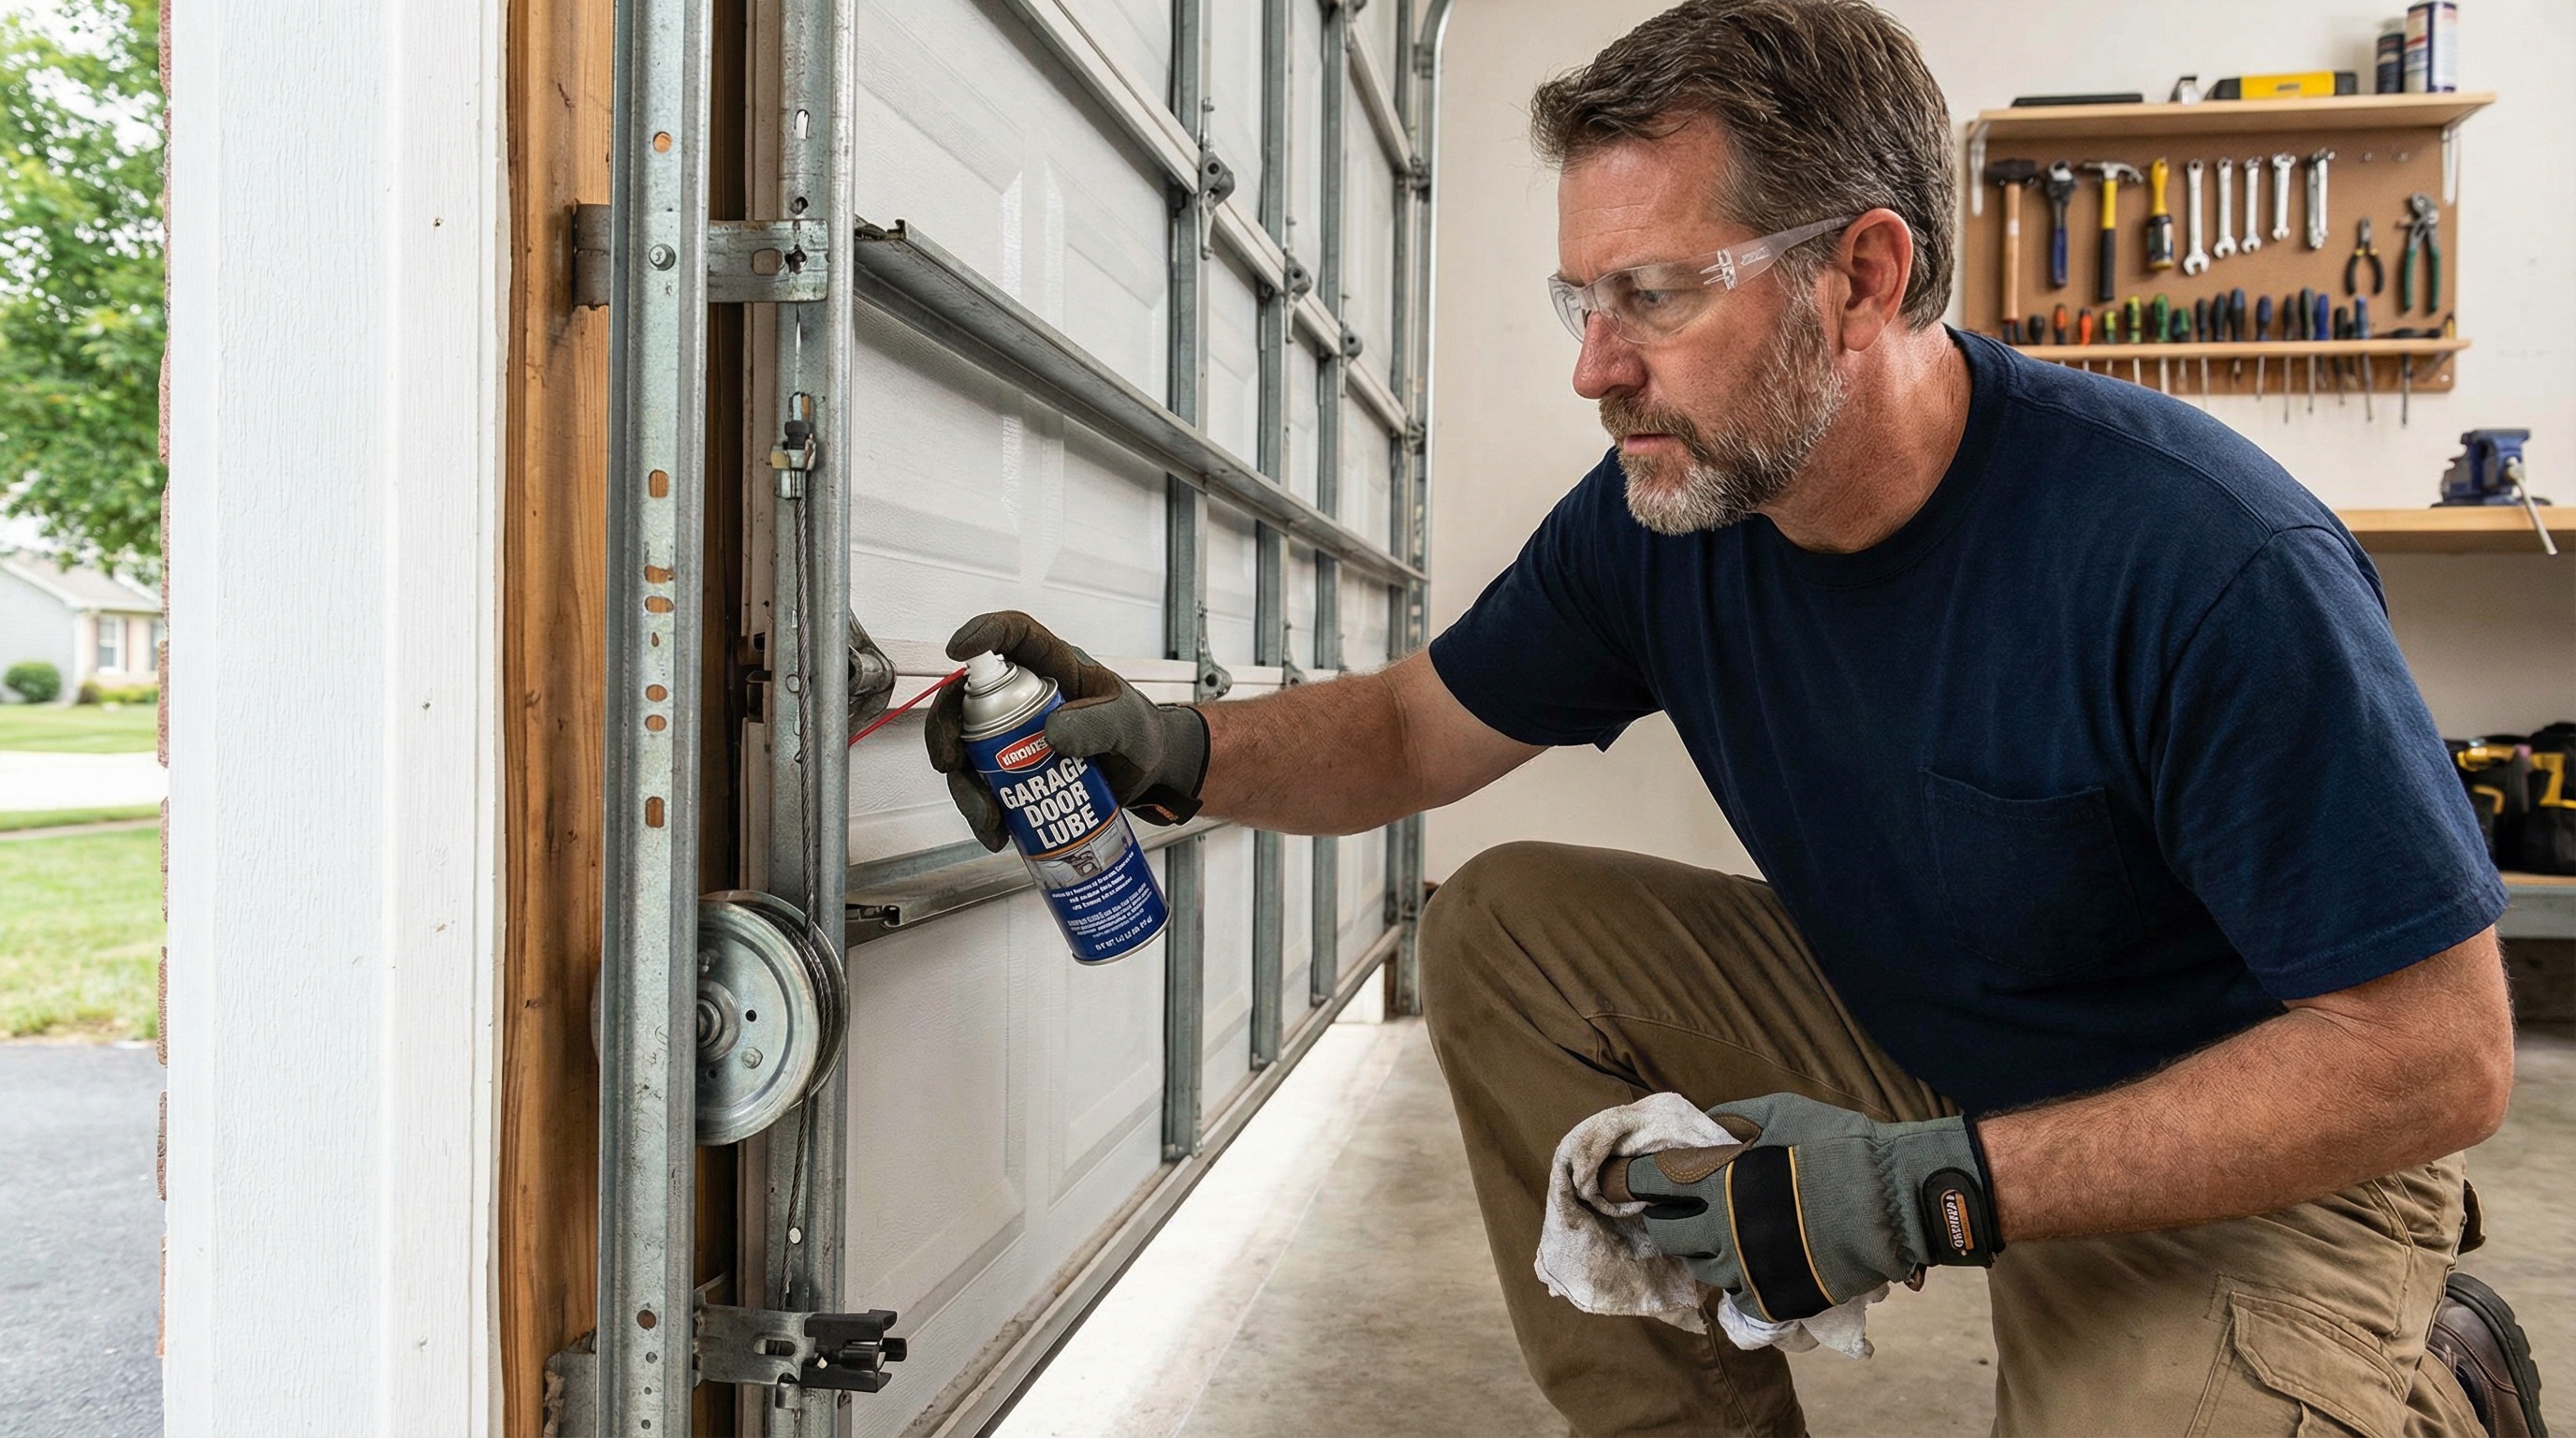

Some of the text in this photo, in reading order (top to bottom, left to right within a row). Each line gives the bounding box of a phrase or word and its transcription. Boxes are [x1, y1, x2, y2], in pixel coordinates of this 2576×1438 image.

[1000, 756, 1088, 809] GARAGE
[1023, 781, 1090, 829] DOOR
[1036, 802, 1100, 850] LUBE
